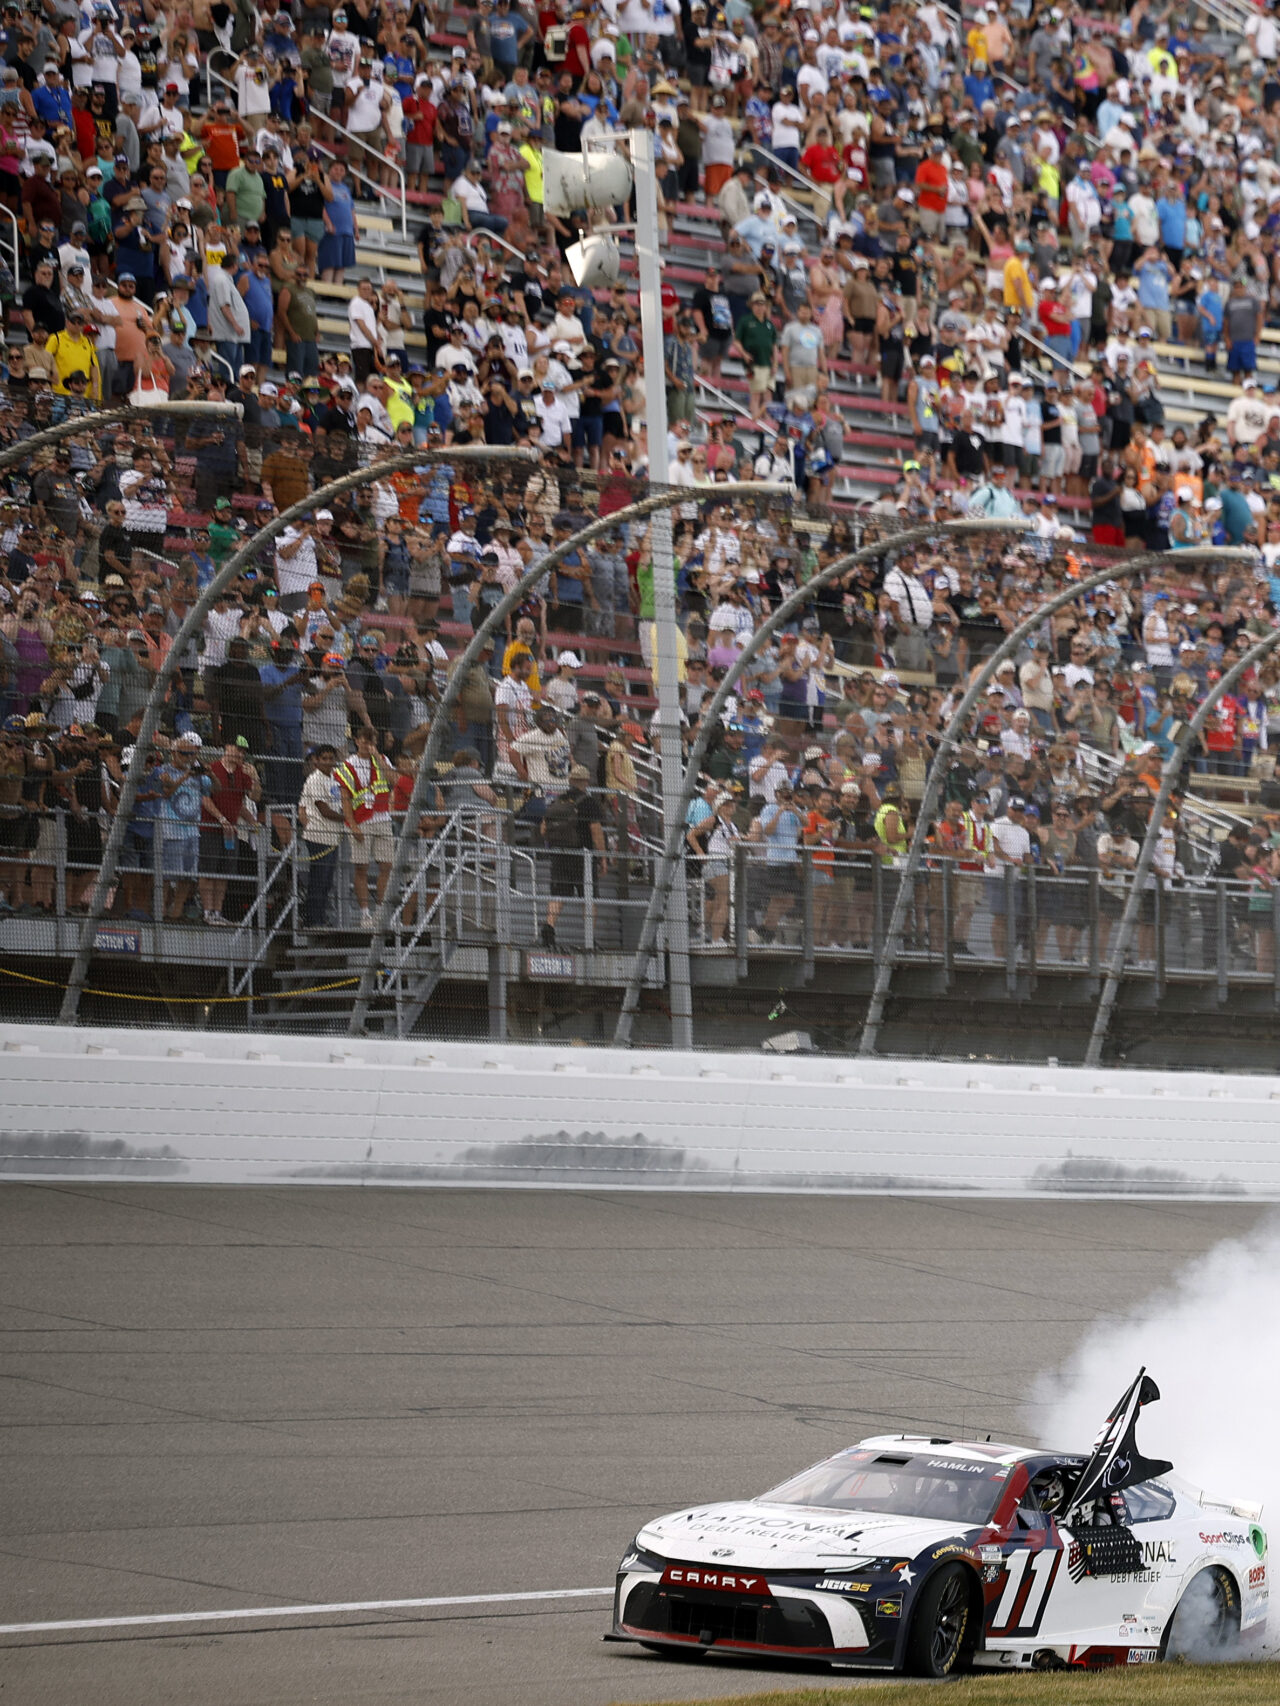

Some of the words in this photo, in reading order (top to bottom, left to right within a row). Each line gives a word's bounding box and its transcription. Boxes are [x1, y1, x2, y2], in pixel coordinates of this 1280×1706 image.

[93, 934, 124, 950] ECTION
[927, 1459, 985, 1475] HAMLIN
[689, 1522, 743, 1534] DEBT
[744, 1527, 816, 1543] RELIEF
[1110, 1572, 1132, 1584] DEBT
[1132, 1571, 1162, 1583] RELIEF
[1248, 1566, 1266, 1584] BOB'S
[991, 1549, 1059, 1628] 11
[1219, 1573, 1235, 1608] EAGLE
[1129, 1649, 1149, 1662] Mobil
